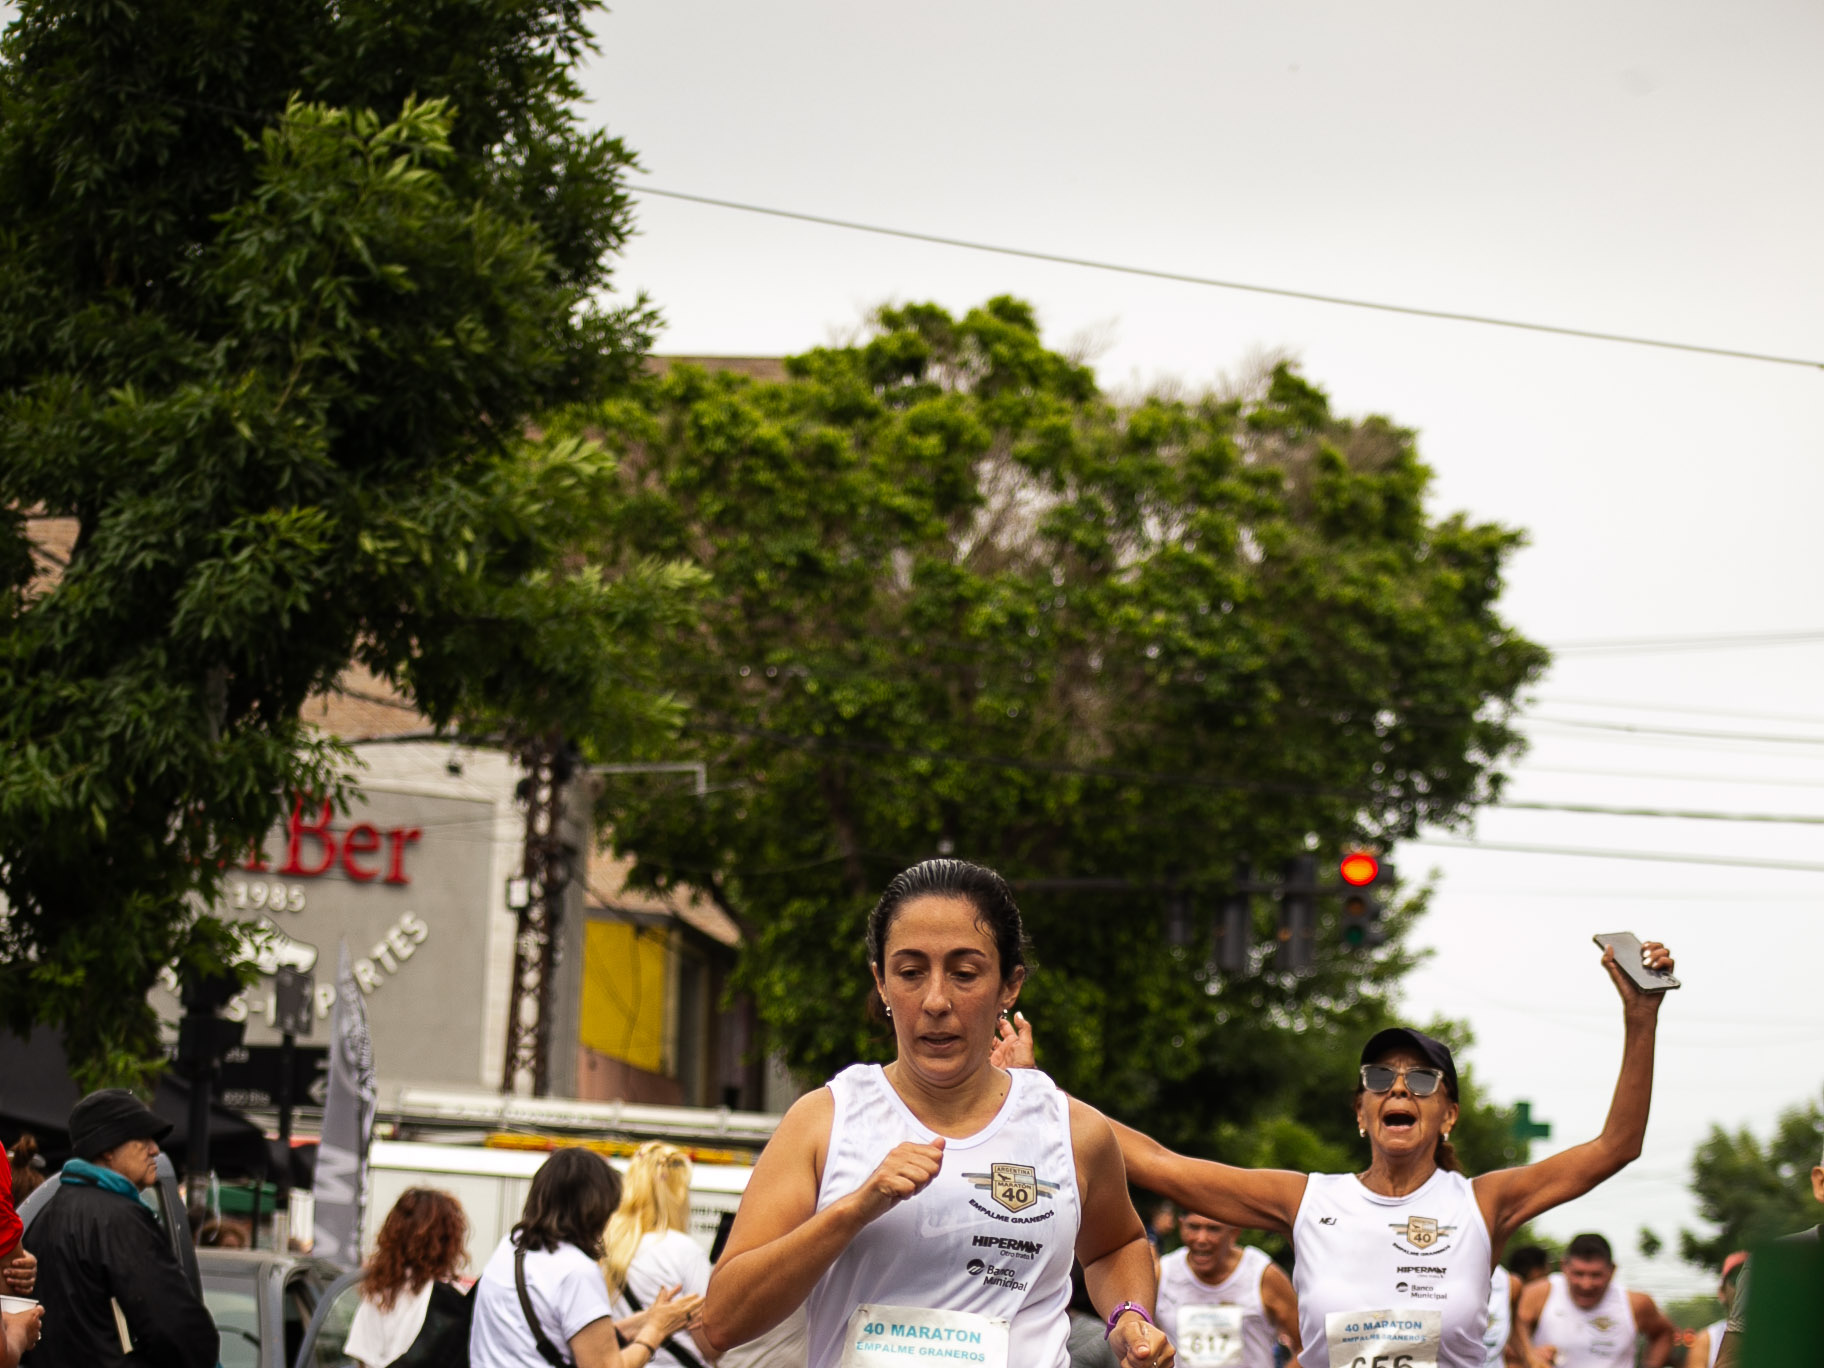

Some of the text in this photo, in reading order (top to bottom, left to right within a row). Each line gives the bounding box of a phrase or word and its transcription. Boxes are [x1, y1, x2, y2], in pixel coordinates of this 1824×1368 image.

[230, 881, 306, 913] 1985
[996, 1167, 1031, 1175] ARGENTINA
[1002, 1188, 1028, 1203] 40
[969, 1199, 1055, 1224] EMPALME GRANEROS
[1413, 1233, 1432, 1244] 40
[1000, 1249, 1015, 1258] Otro
[1411, 1284, 1434, 1292] Banco
[1410, 1291, 1448, 1300] Municipal
[1345, 1320, 1422, 1332] 40 MARATON
[863, 1322, 982, 1344] 40 MARATON
[856, 1341, 985, 1362] EMPALME GRANEROS
